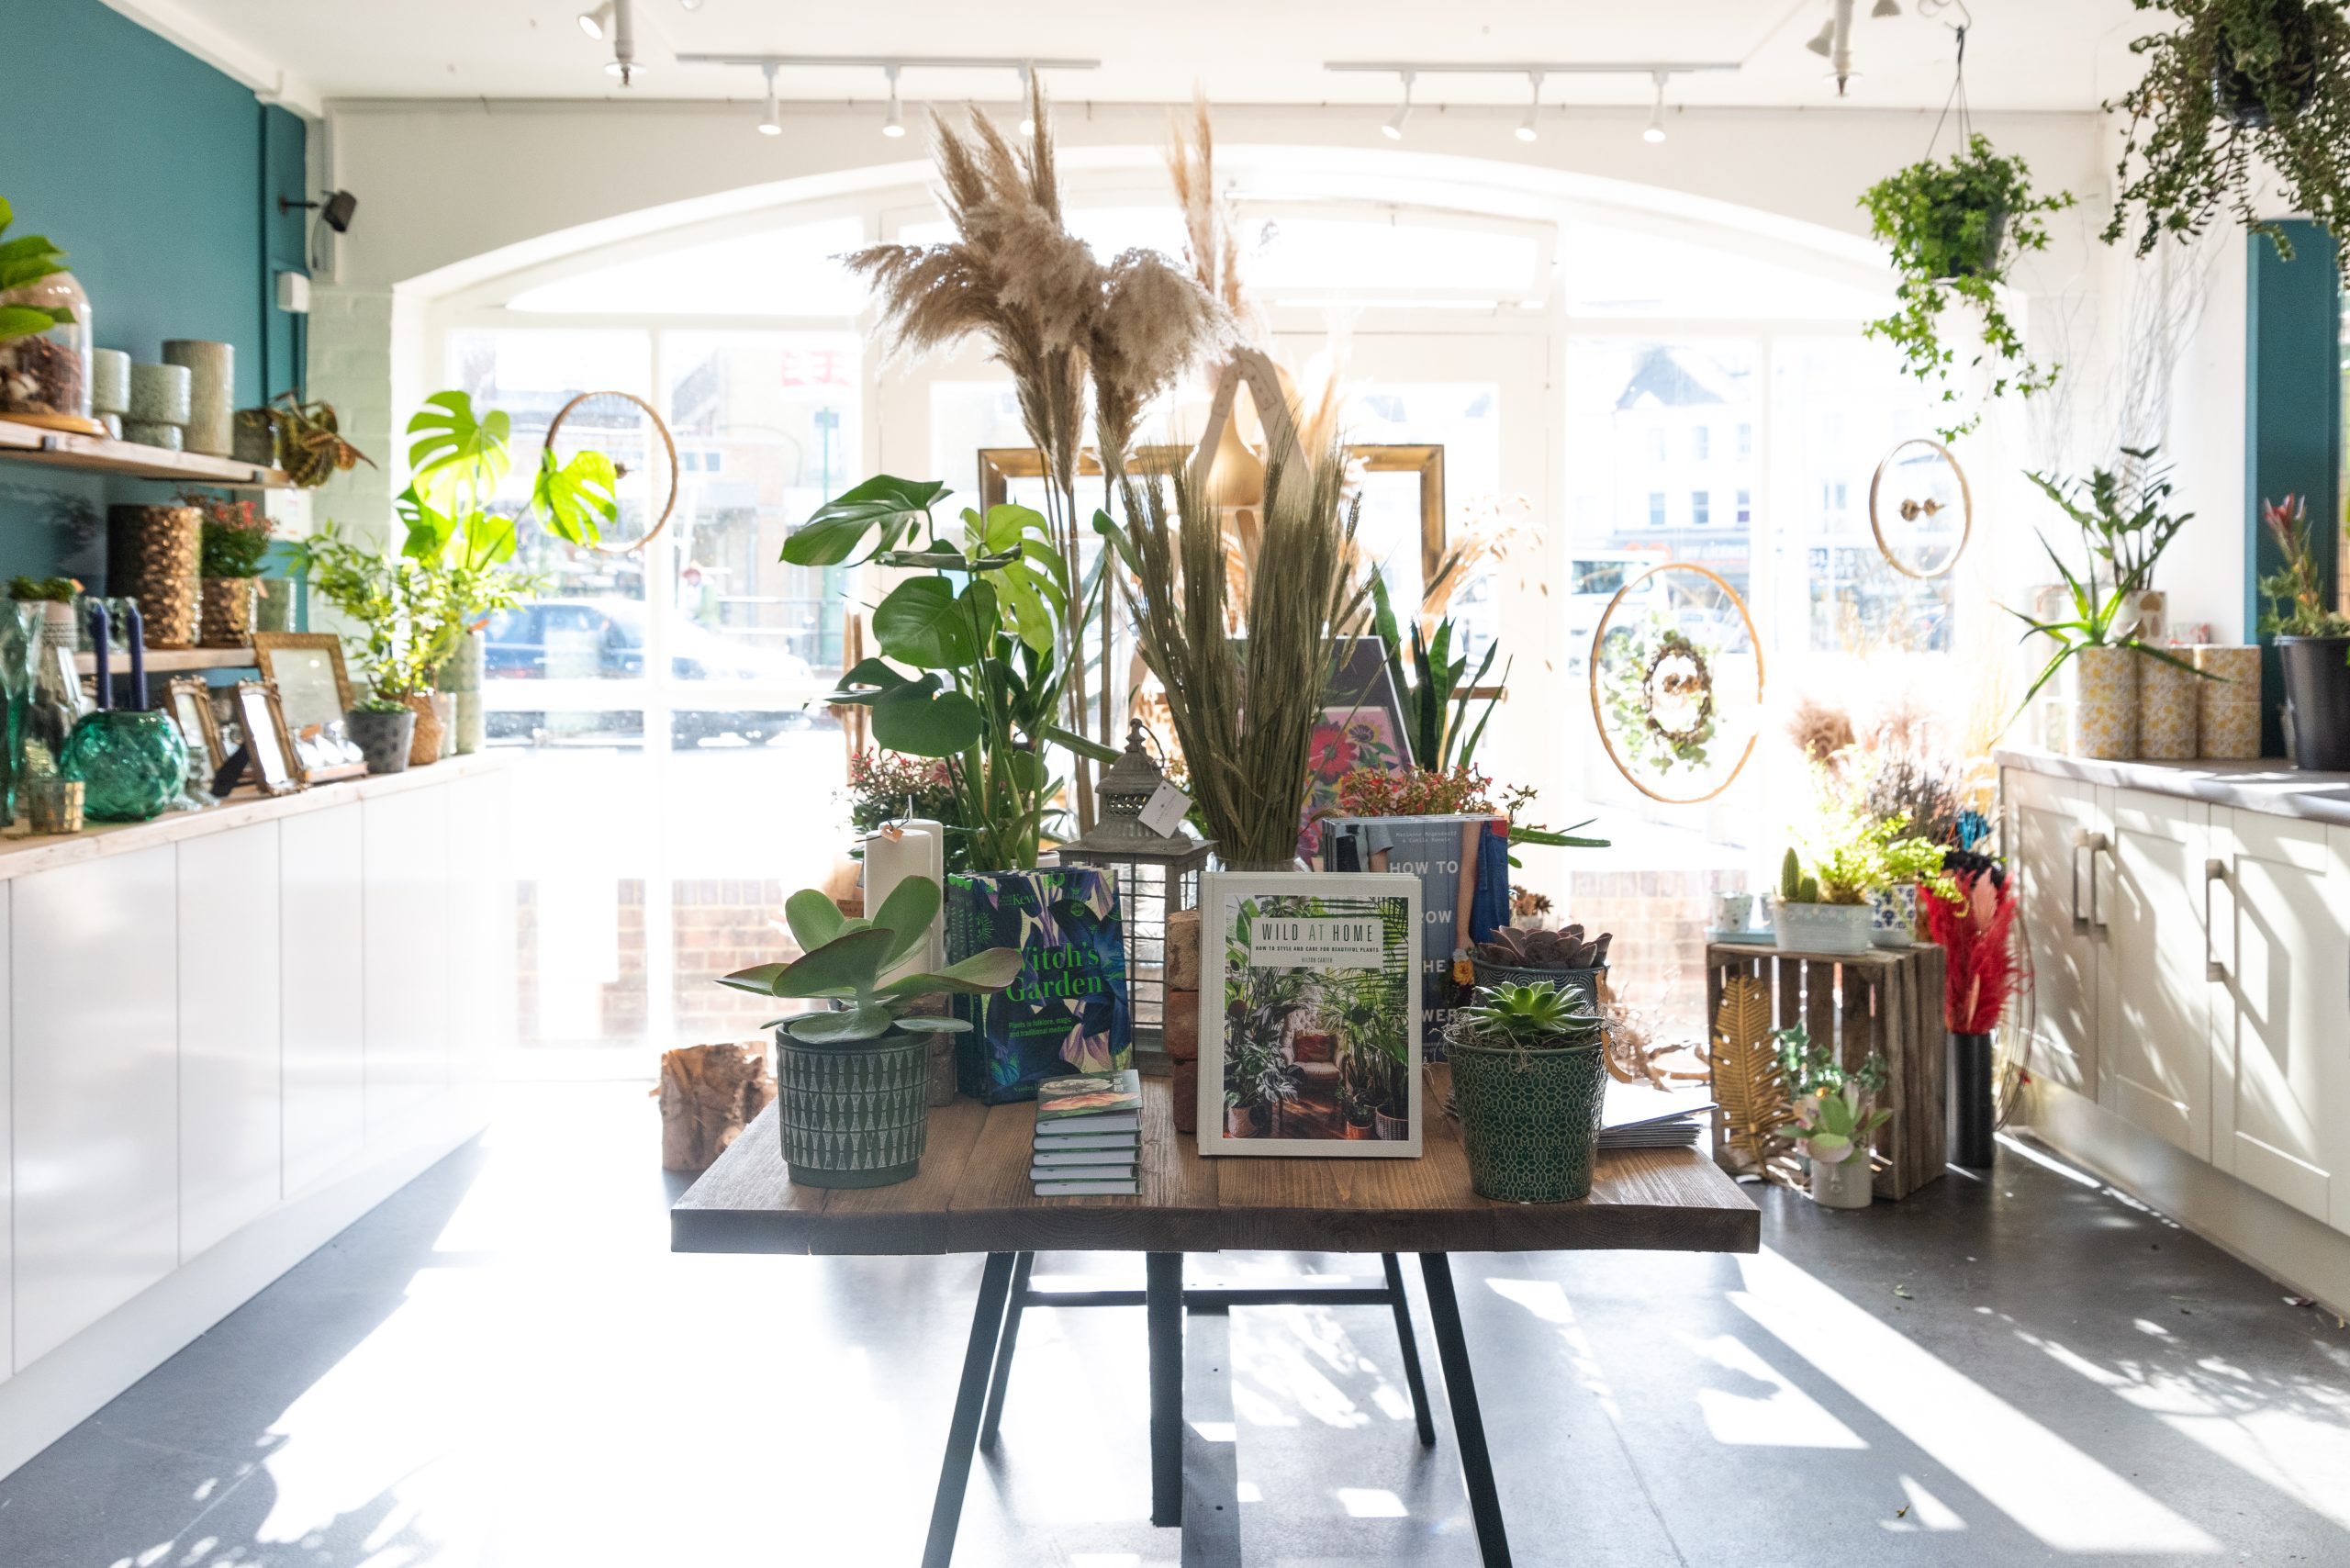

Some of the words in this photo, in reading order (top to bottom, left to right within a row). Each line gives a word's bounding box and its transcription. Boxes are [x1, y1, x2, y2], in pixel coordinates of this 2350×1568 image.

[1389, 862, 1428, 875] HOW
[1436, 860, 1459, 874] TO
[1013, 893, 1035, 906] Kew
[1421, 910, 1452, 924] OW
[1262, 924, 1298, 940] WILD
[1308, 924, 1325, 941] AT
[1333, 924, 1372, 942] HOME
[1423, 959, 1447, 973] HE
[1006, 970, 1102, 1001] Garden
